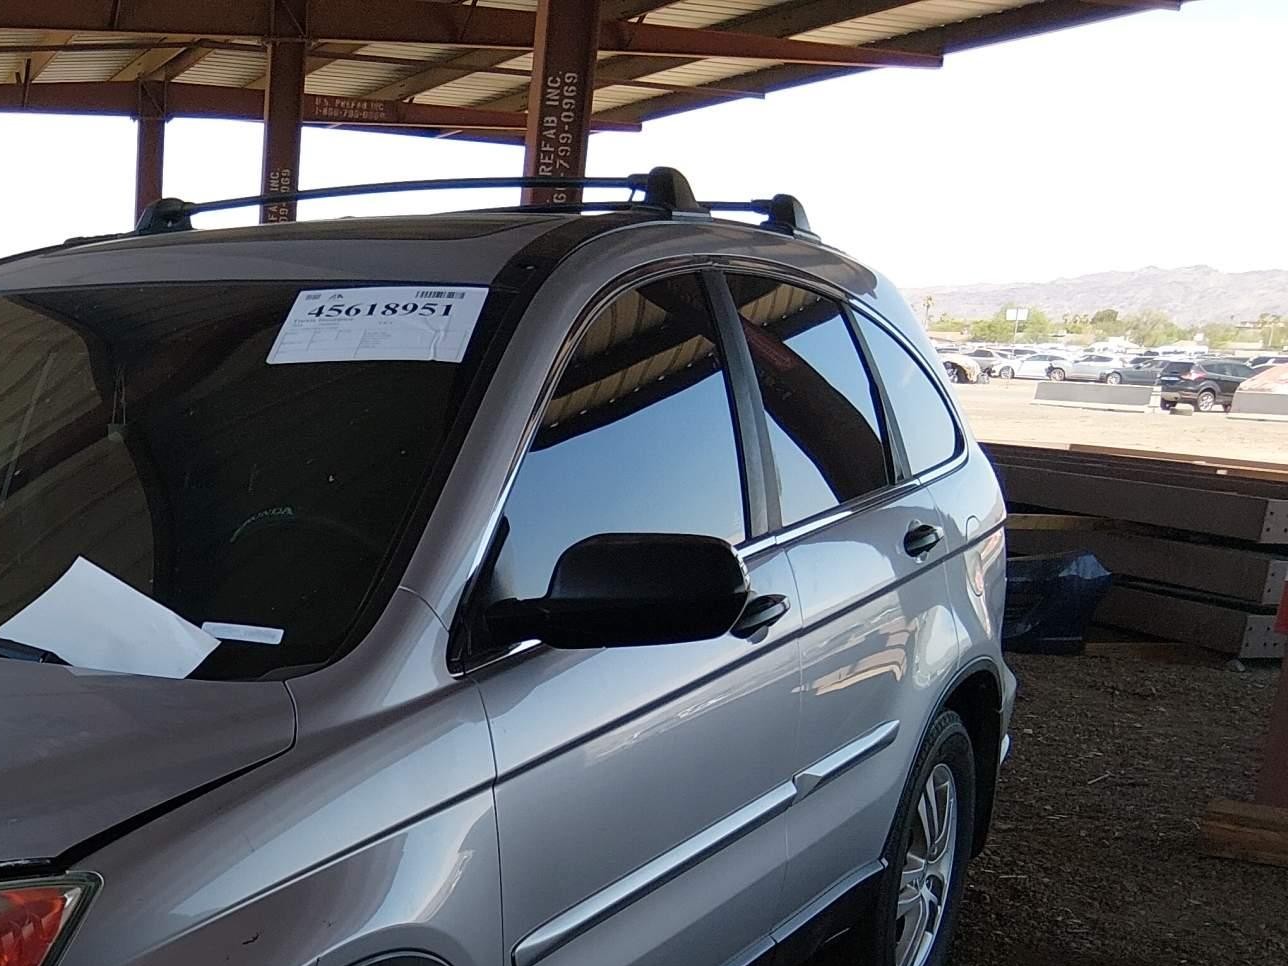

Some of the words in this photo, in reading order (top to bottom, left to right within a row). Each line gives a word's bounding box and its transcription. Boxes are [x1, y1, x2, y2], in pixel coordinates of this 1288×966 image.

[545, 71, 562, 106] INC.
[539, 116, 558, 176] REFAB
[307, 303, 452, 317] 45618951
